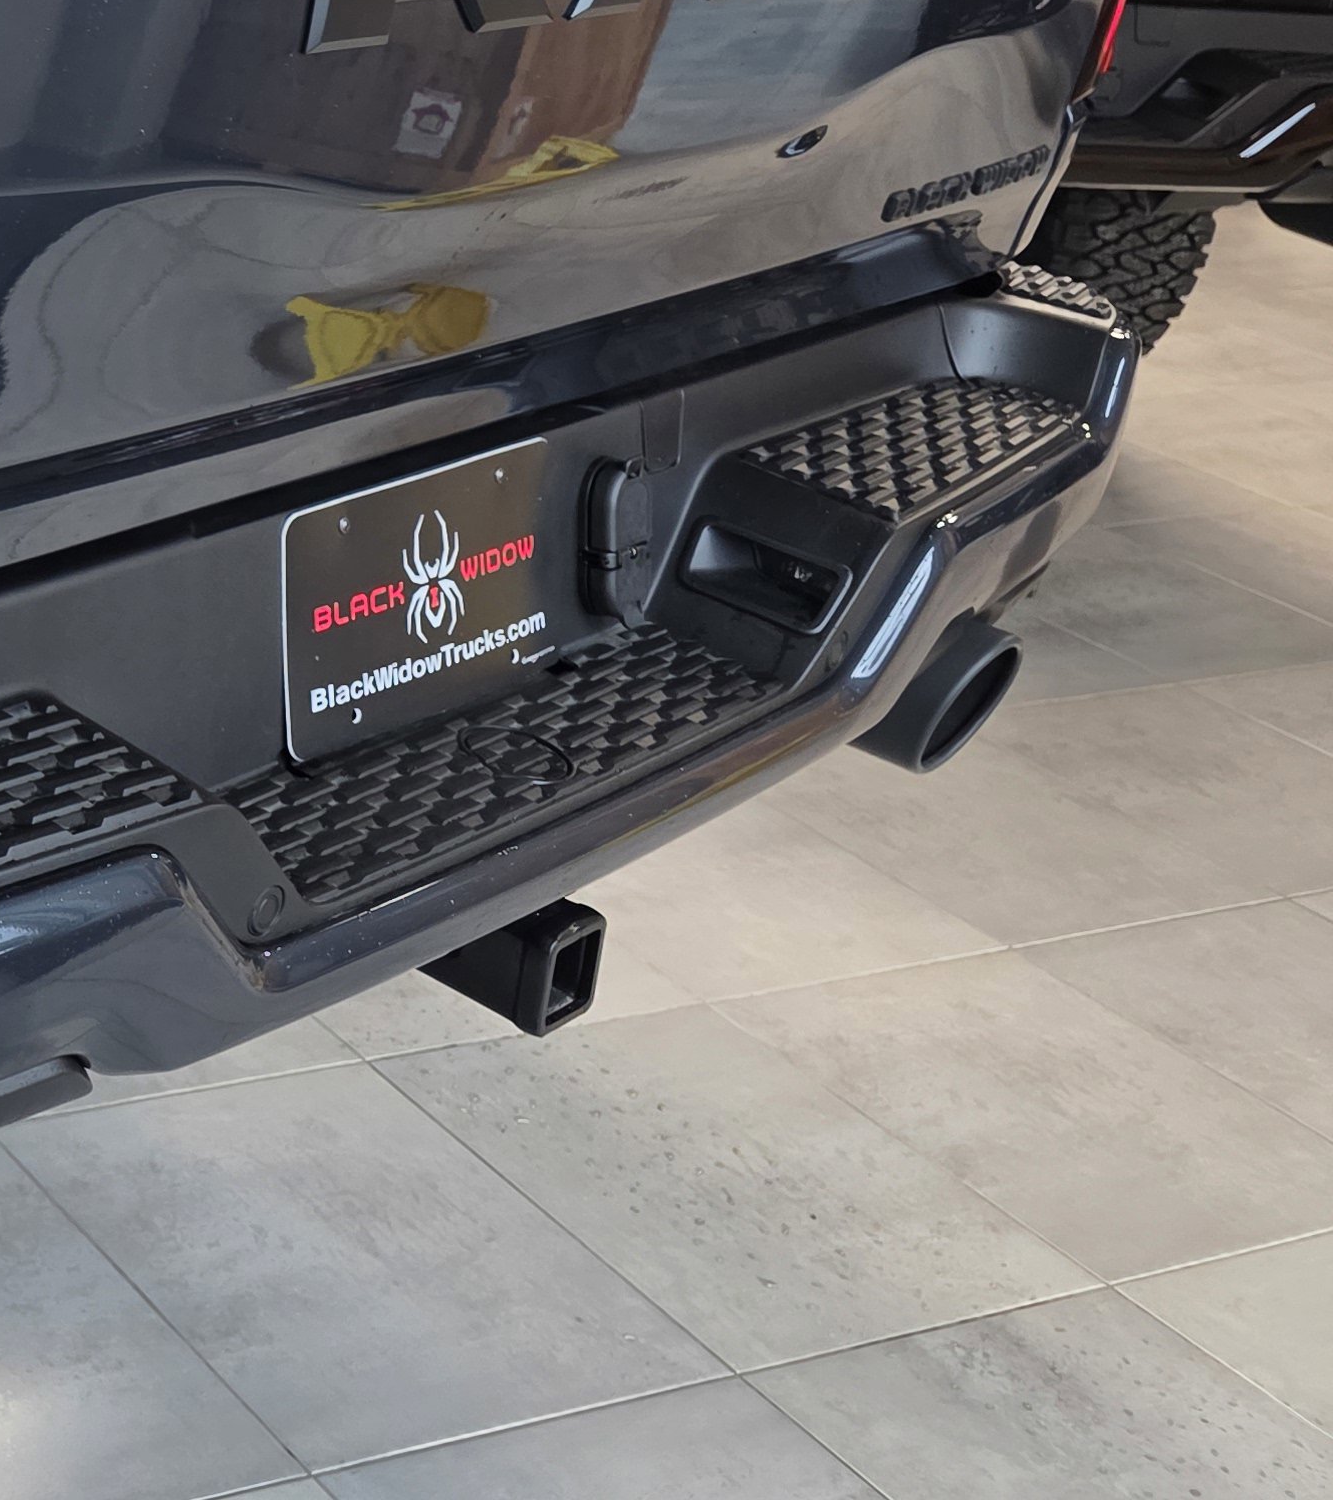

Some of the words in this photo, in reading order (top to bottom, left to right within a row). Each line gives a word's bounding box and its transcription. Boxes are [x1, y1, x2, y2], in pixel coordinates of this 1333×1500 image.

[312, 581, 406, 634] BLACK
[459, 534, 536, 582] WIDOW
[309, 610, 546, 714] BlackWidowTrucks.com
